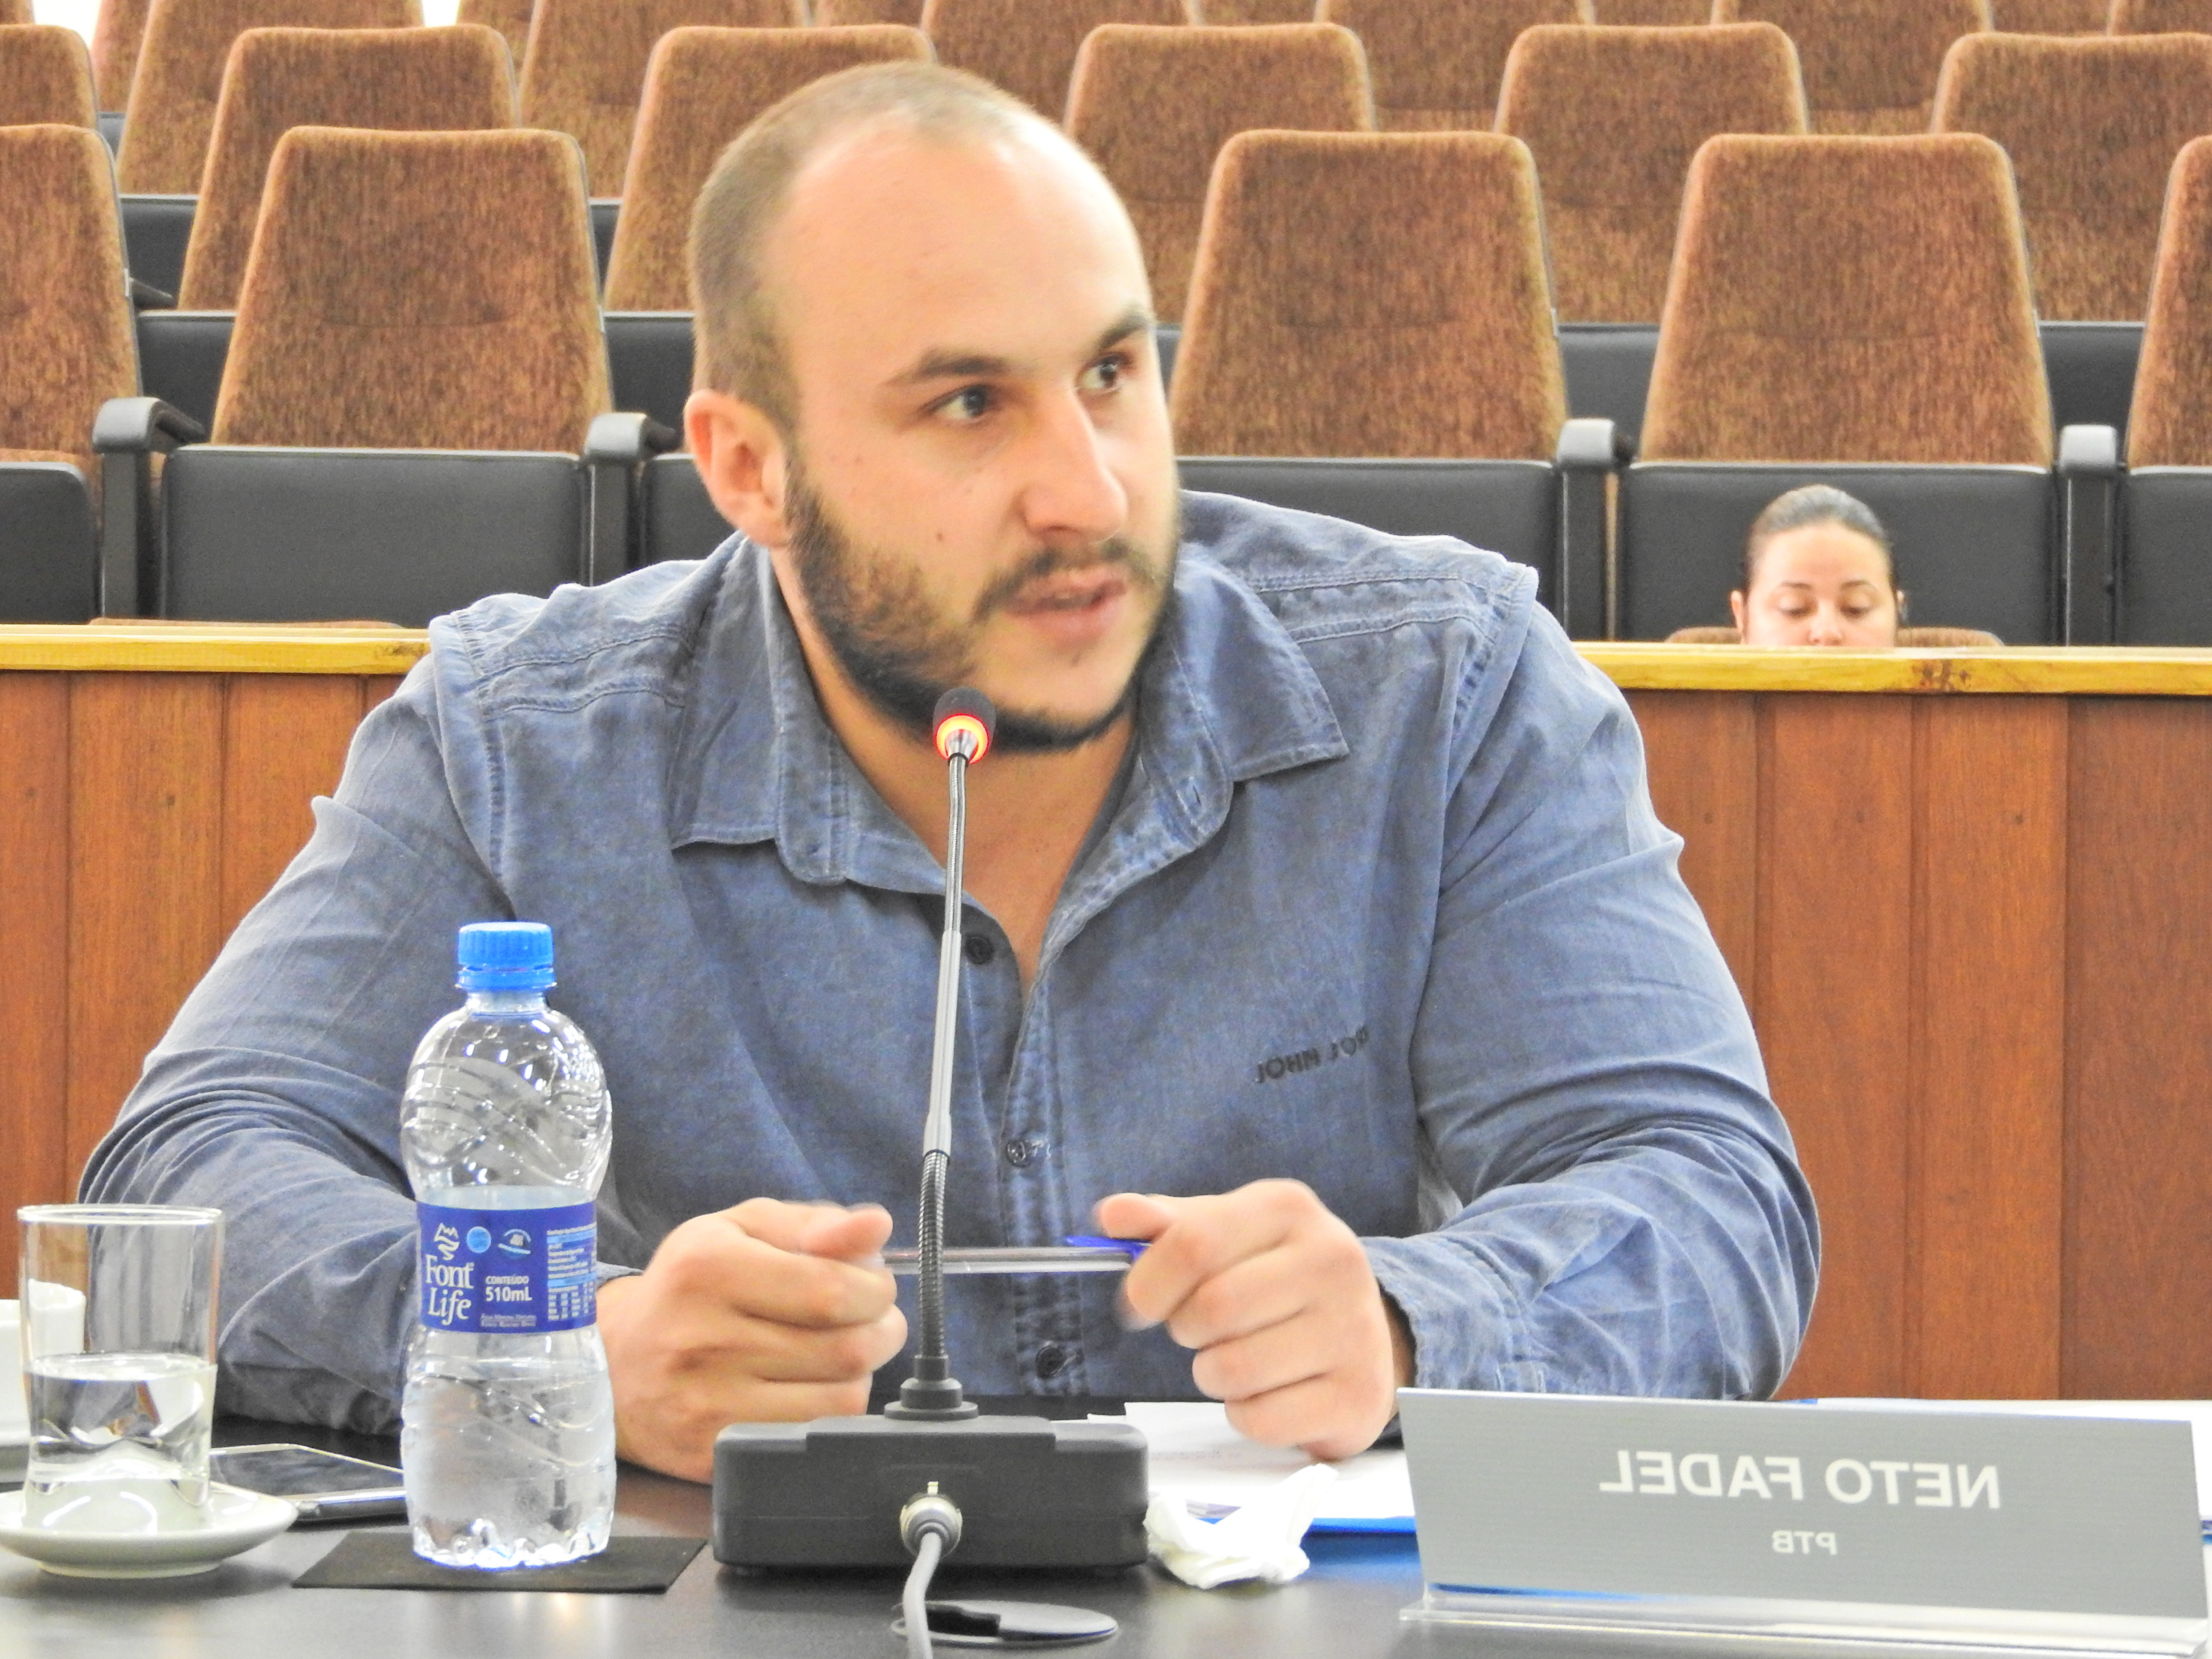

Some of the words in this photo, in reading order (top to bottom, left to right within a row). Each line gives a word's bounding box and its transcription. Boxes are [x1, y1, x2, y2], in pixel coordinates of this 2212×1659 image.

[1257, 1048, 1321, 1084] JOHN
[425, 1254, 475, 1289] Font
[428, 1287, 472, 1326] Life
[486, 1287, 533, 1302] 510mL
